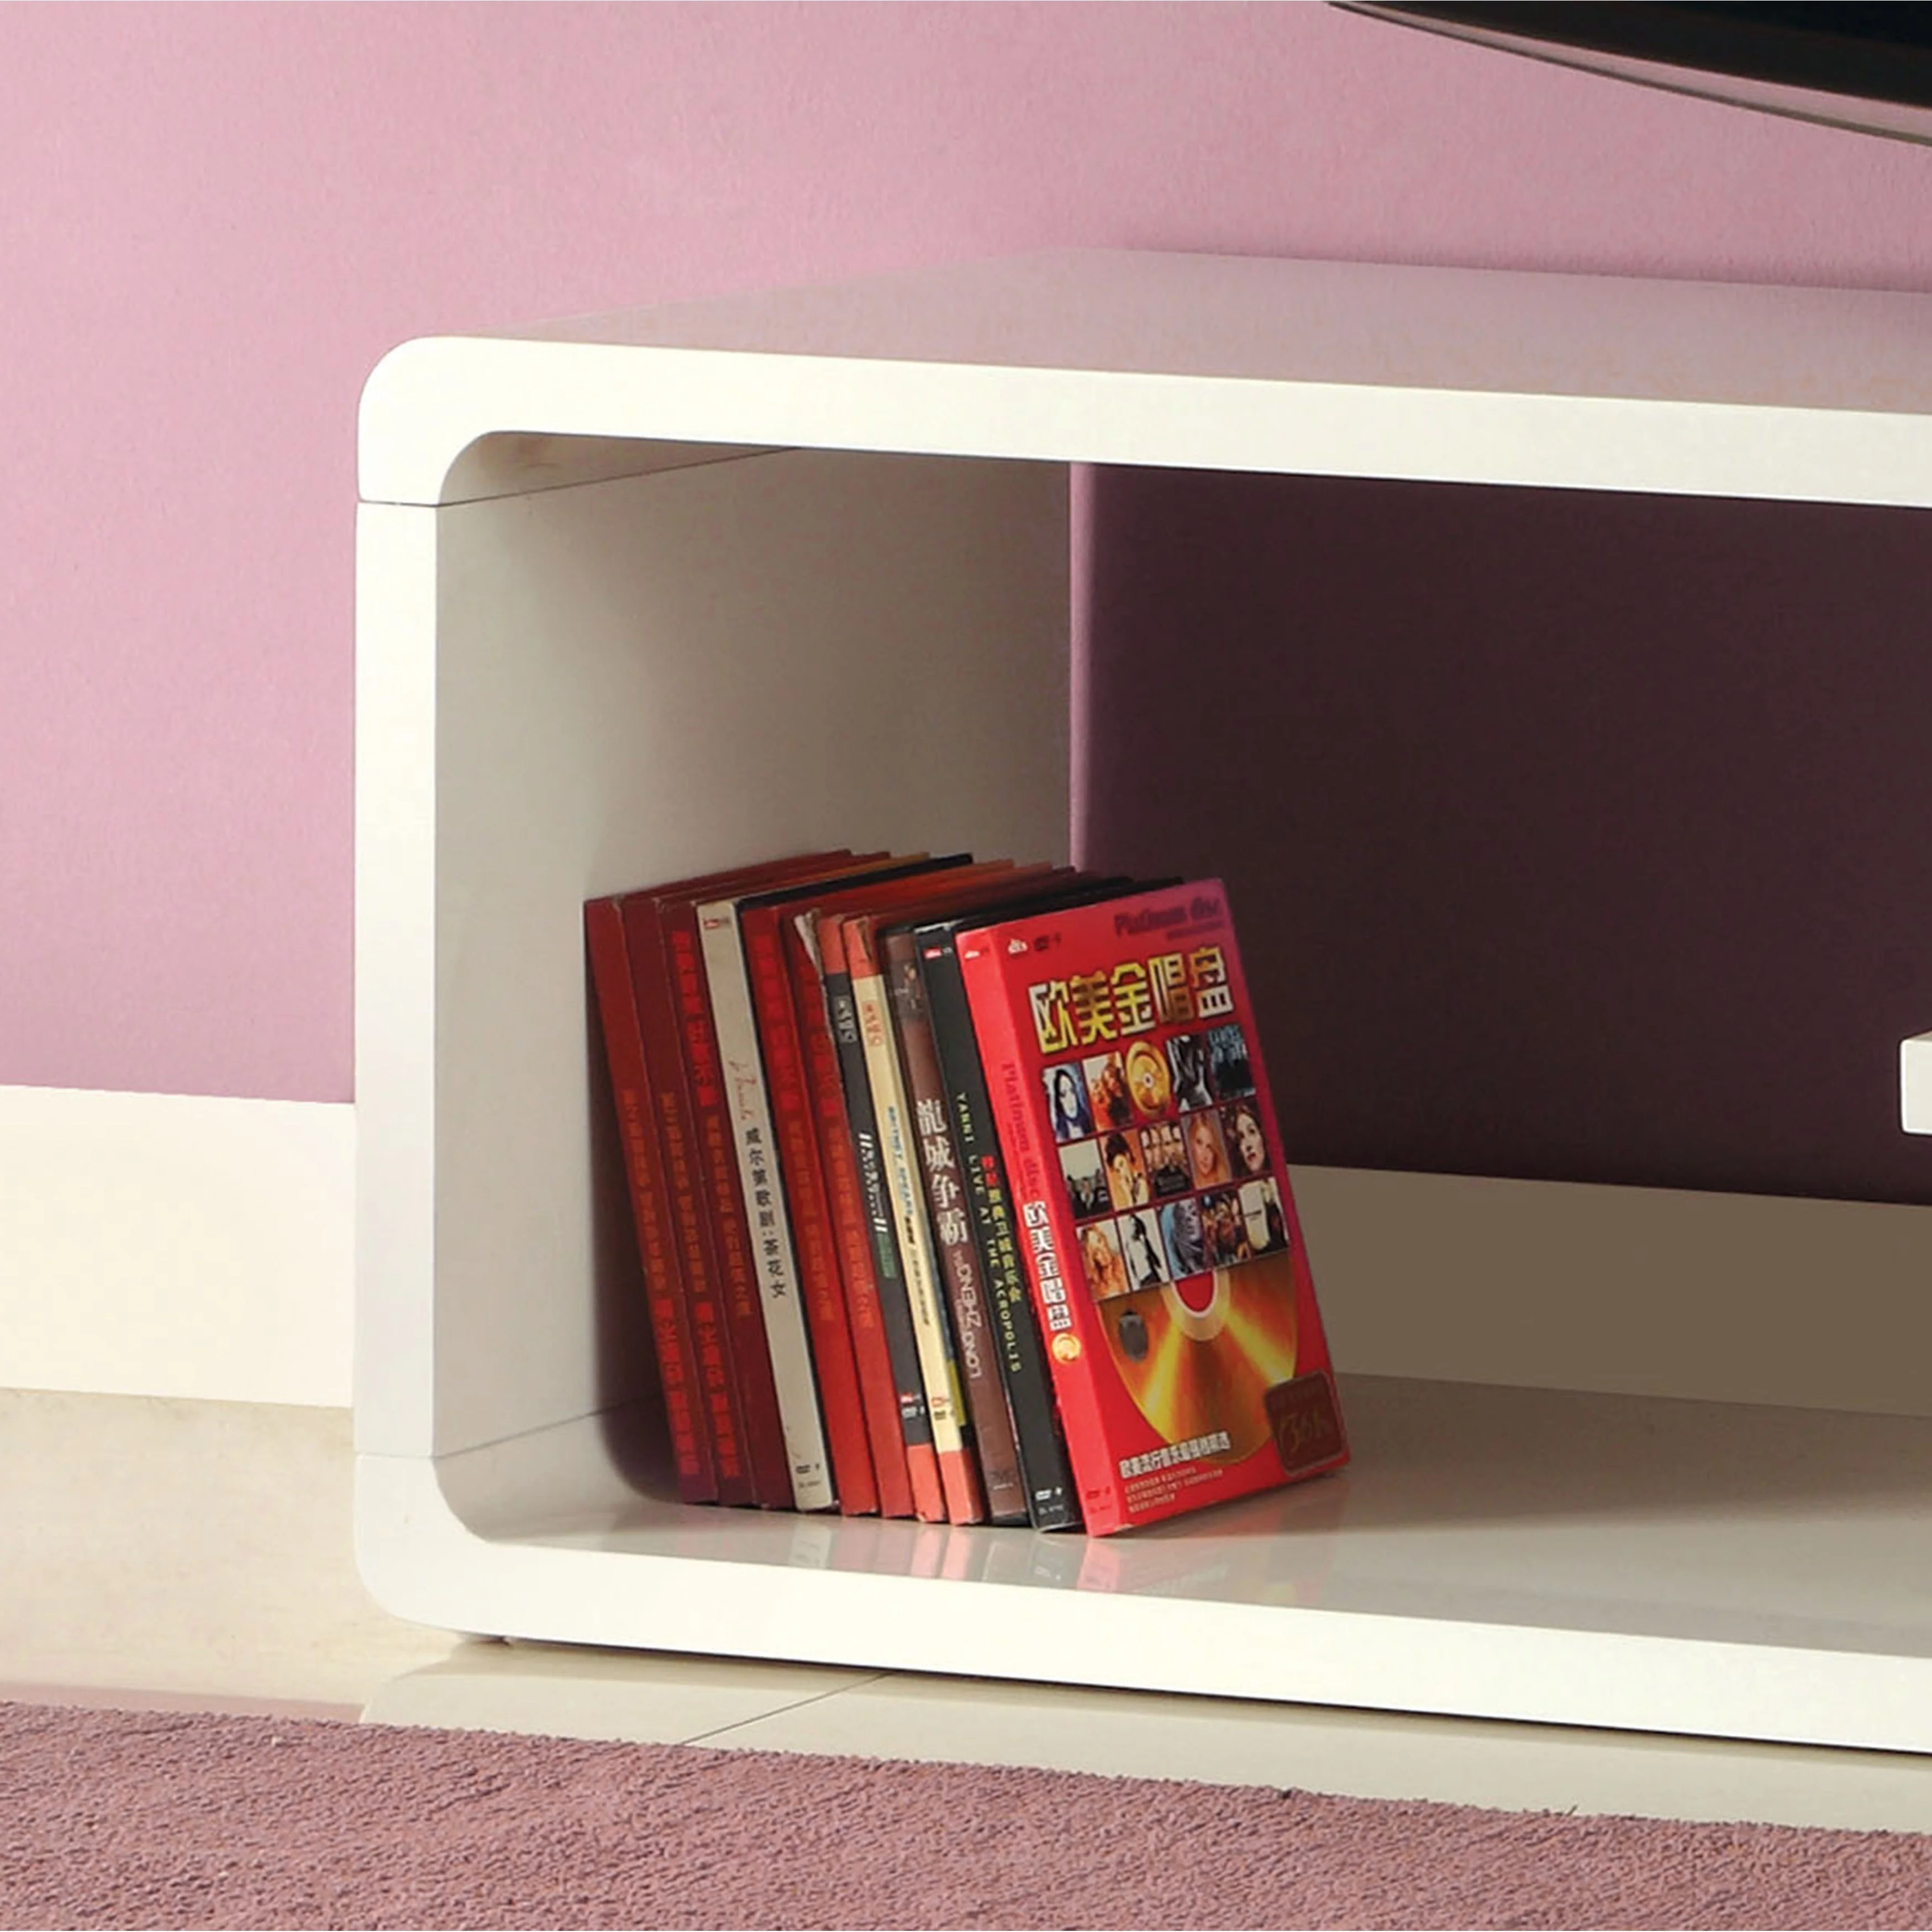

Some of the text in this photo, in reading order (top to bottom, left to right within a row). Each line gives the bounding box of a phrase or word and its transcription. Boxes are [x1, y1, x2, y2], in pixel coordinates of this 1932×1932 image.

[954, 1092, 1022, 1372] YANNI LIVE AT THE ACROPOLIS
